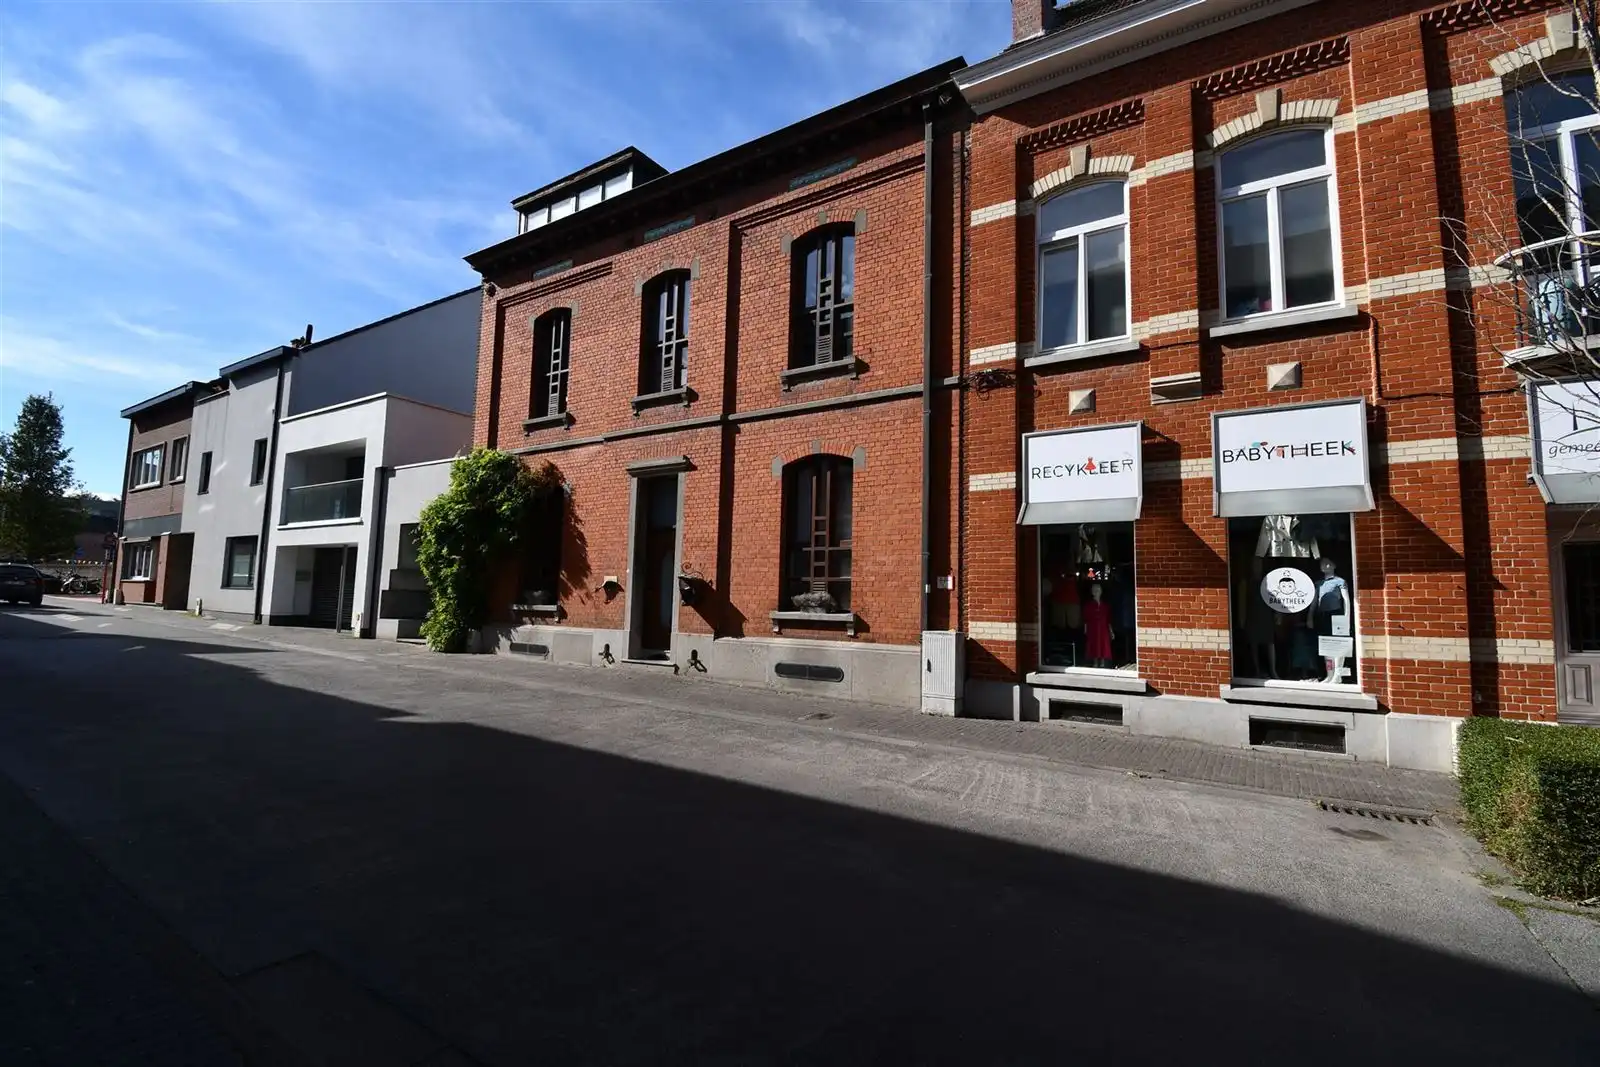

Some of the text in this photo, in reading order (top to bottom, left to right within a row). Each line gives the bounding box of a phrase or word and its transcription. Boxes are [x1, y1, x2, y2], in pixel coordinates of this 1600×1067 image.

[1222, 440, 1356, 464] BABYTHEEK
[1031, 458, 1134, 480] RECYKLEER
[1268, 597, 1306, 605] BABYTHEEK
